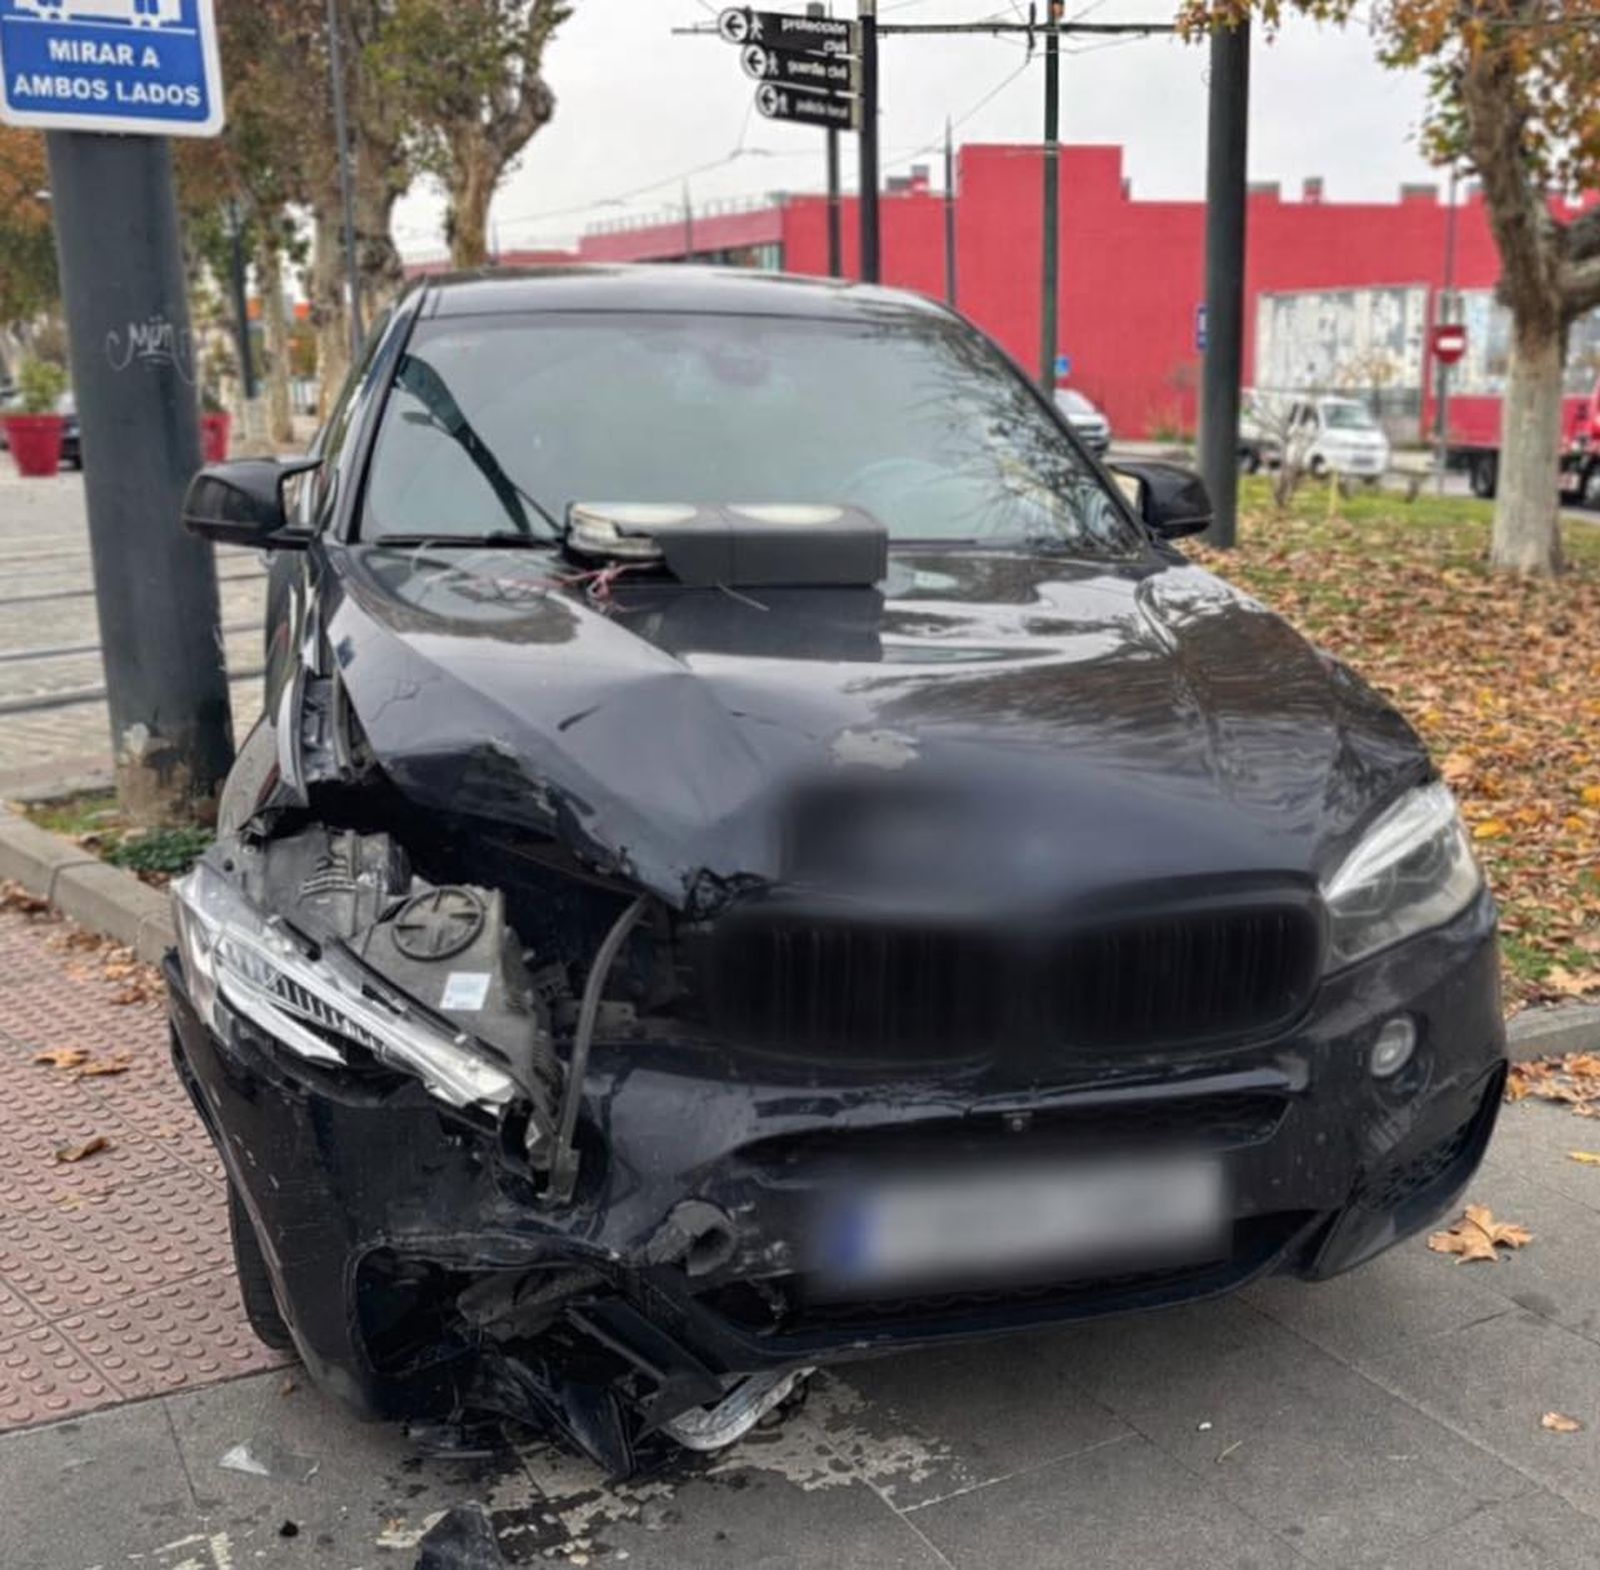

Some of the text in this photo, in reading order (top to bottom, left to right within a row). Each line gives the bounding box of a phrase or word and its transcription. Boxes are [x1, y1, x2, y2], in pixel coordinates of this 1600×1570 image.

[47, 38, 161, 69] MIRAR A
[13, 74, 201, 108] AMBOS LADOS
